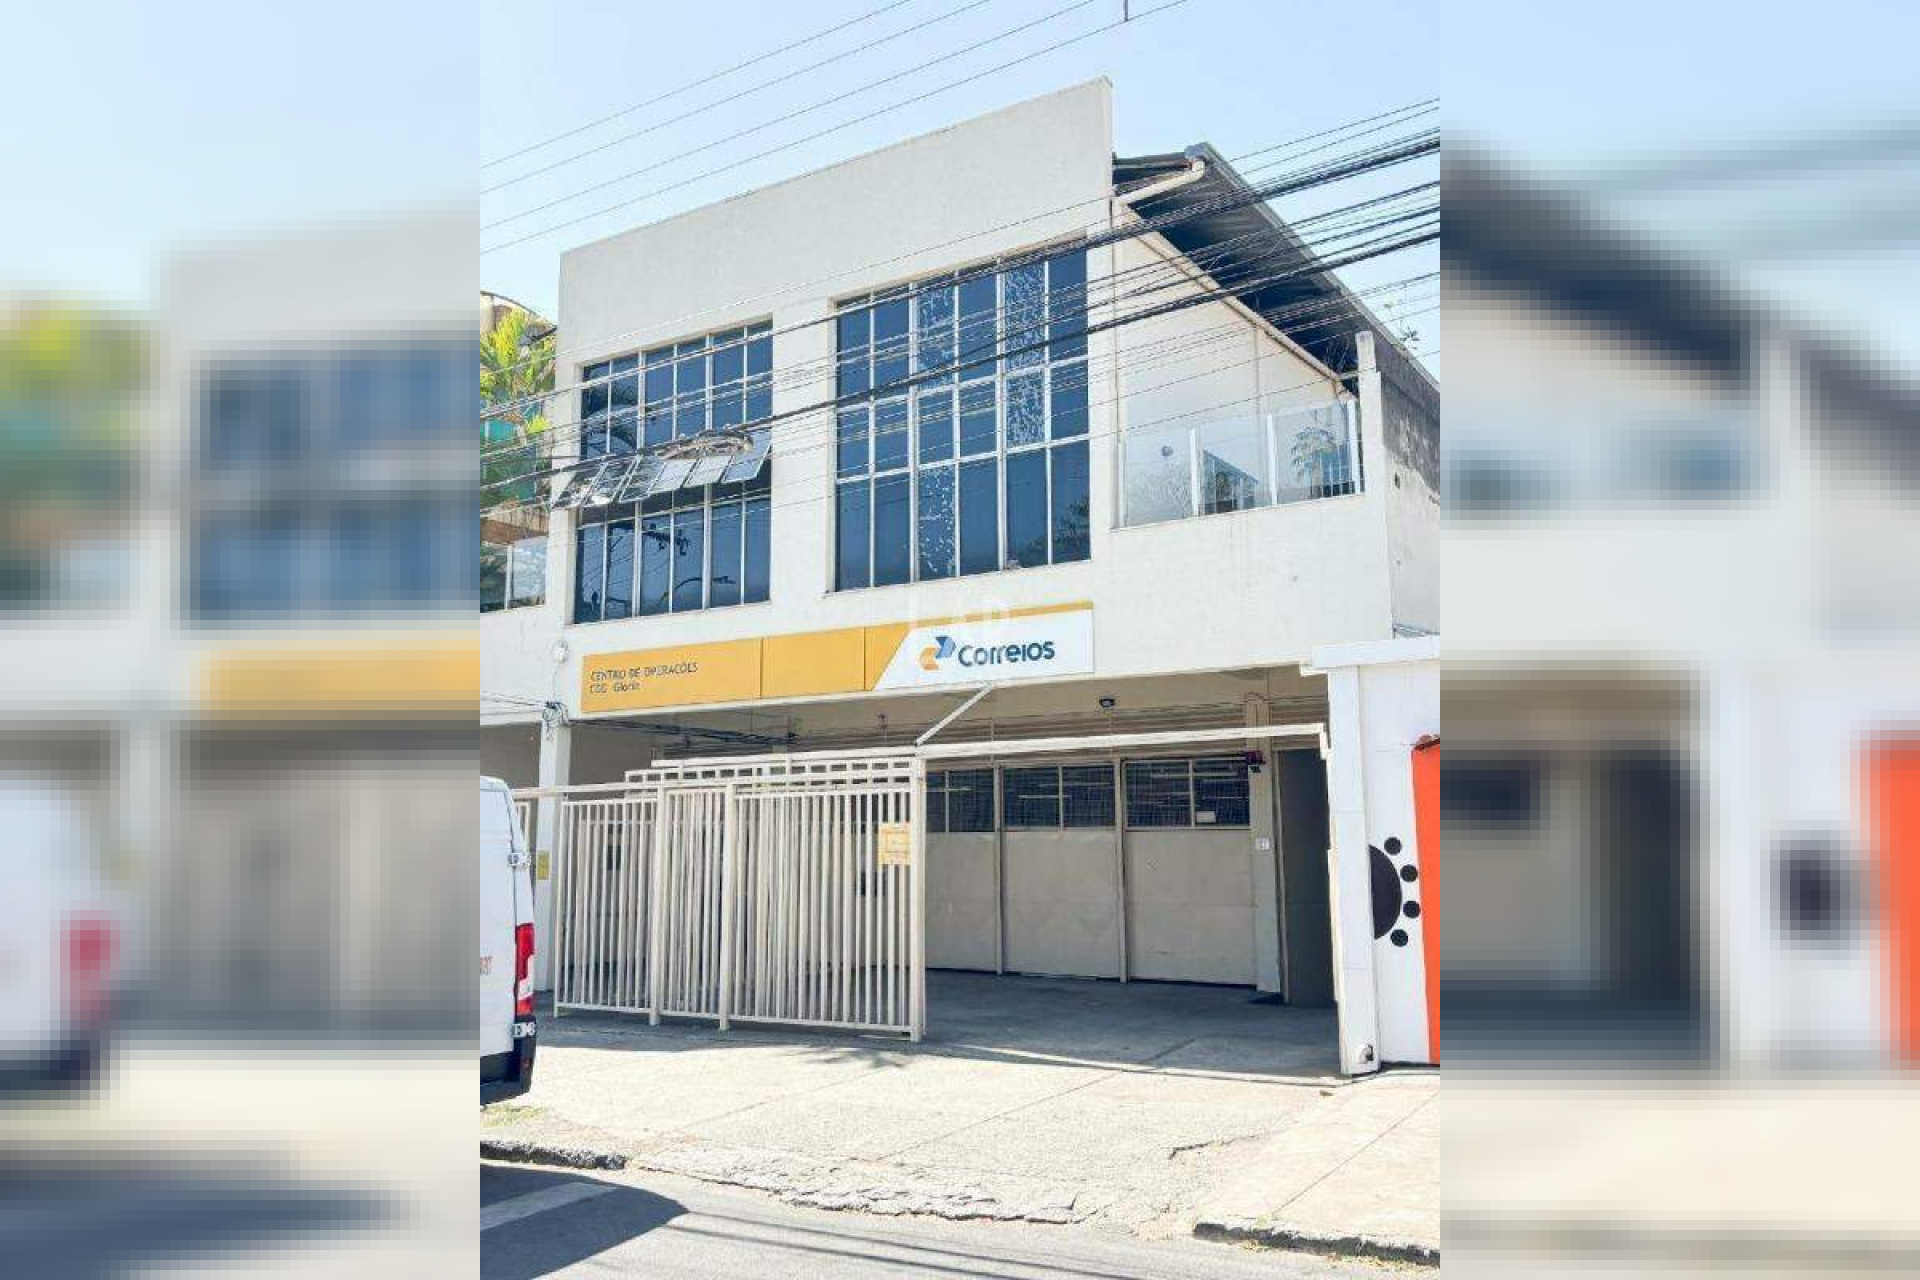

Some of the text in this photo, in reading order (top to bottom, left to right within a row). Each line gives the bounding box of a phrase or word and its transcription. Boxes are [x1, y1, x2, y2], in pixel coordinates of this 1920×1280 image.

[958, 640, 1056, 668] Correios
[589, 669, 626, 681] CENTRO
[629, 666, 641, 679] DE
